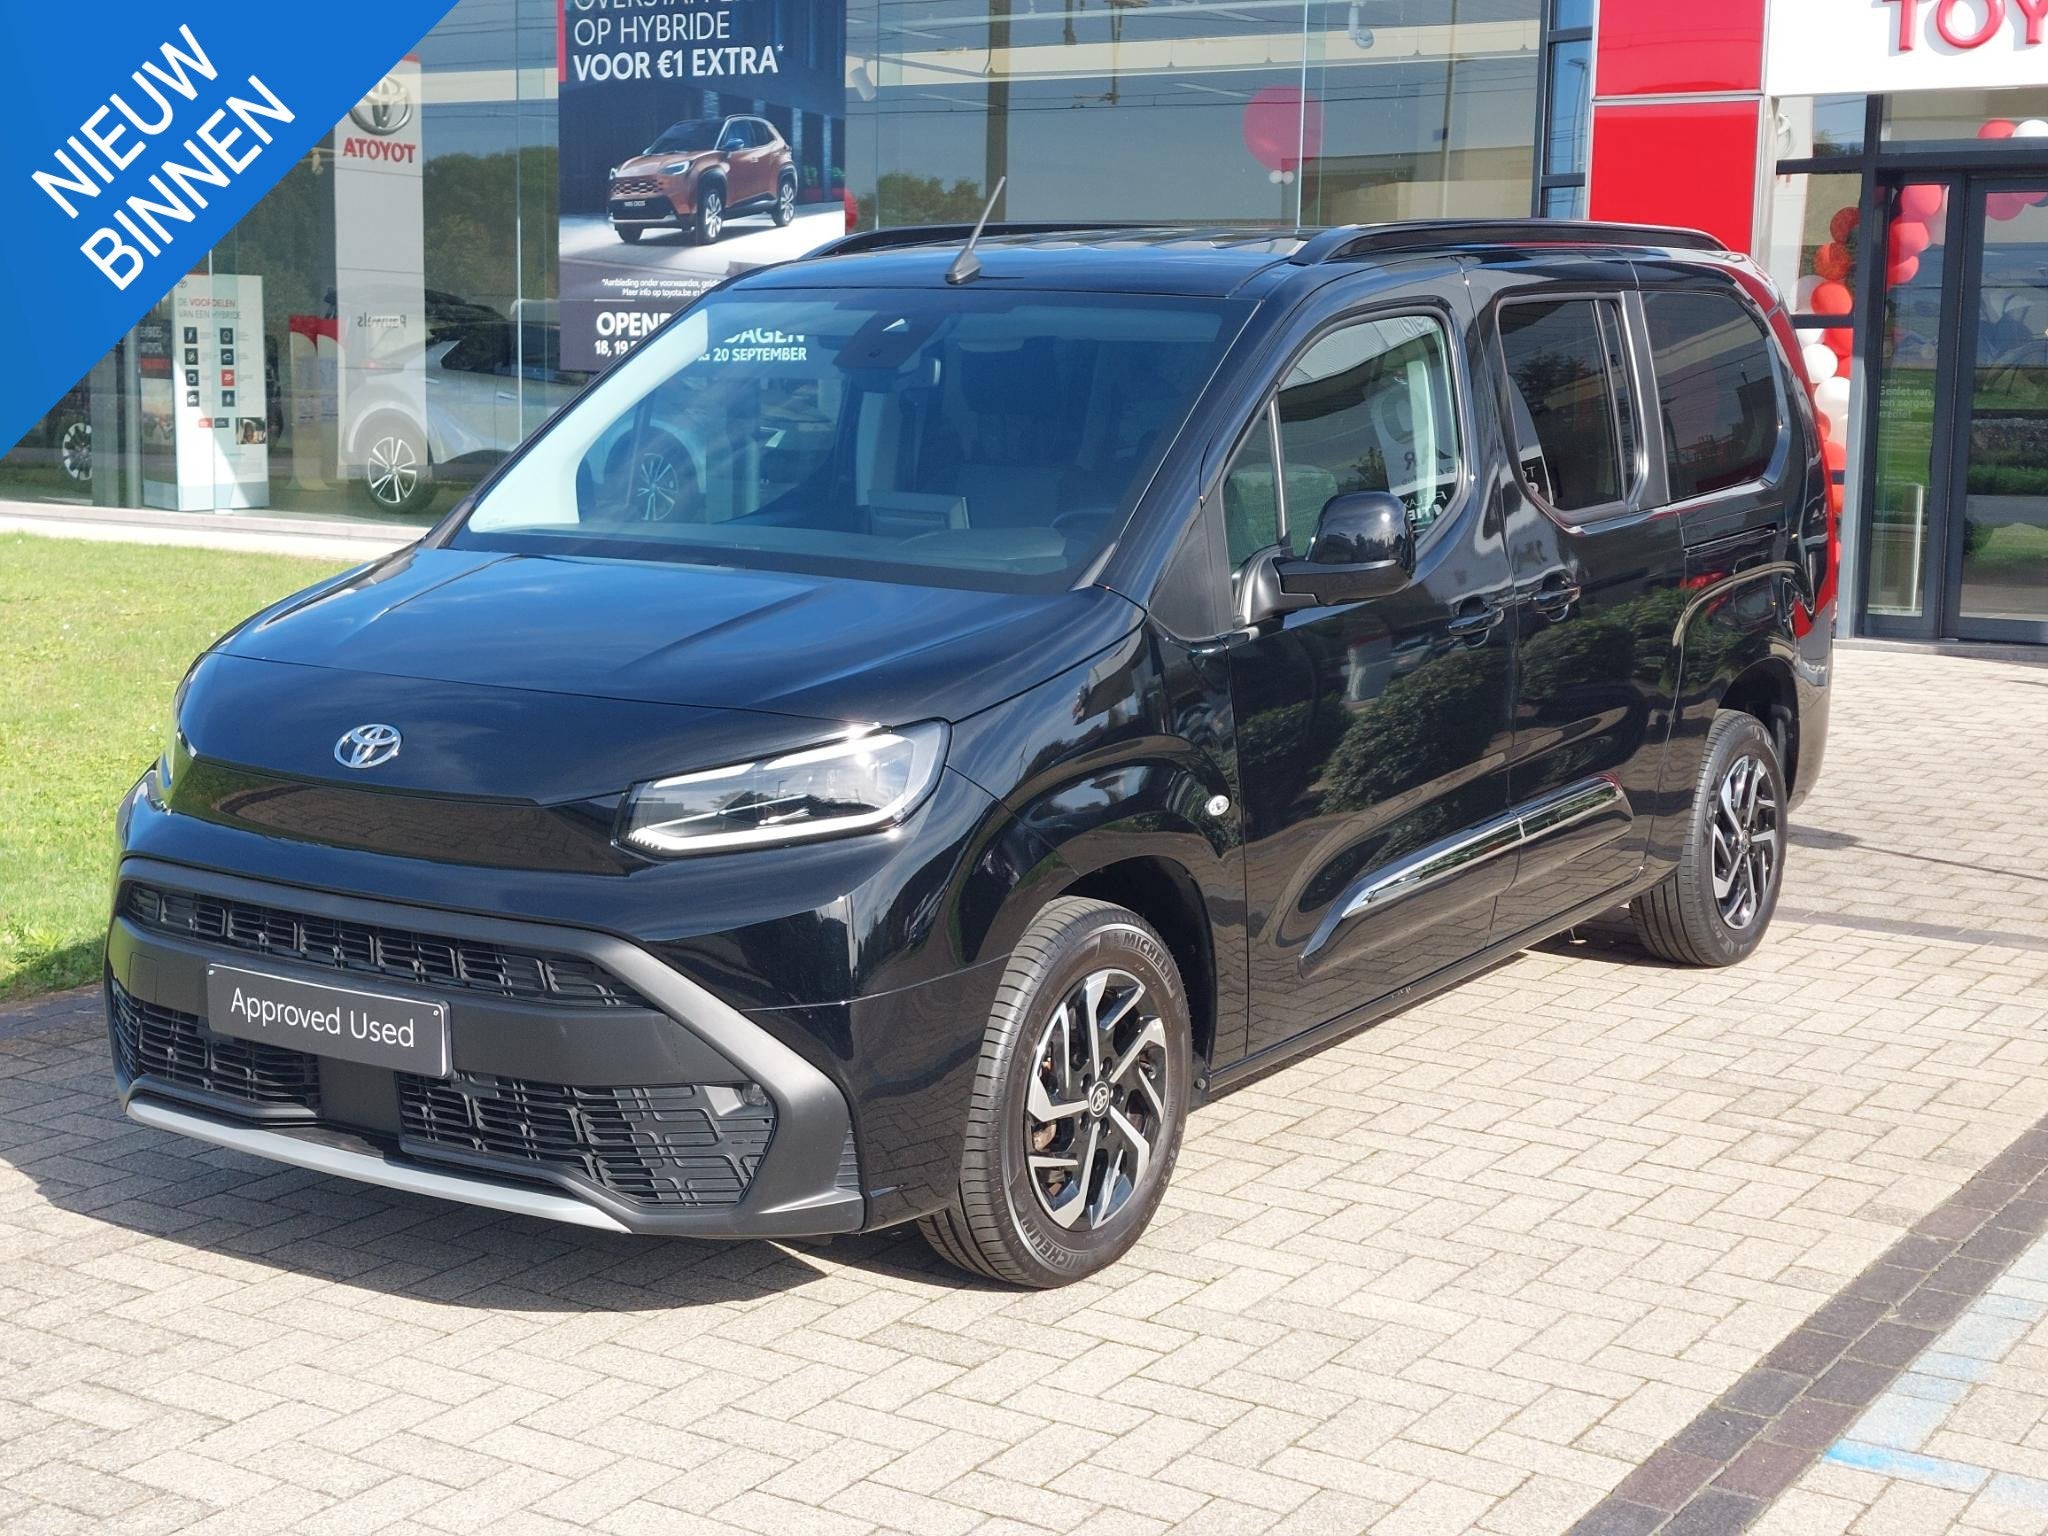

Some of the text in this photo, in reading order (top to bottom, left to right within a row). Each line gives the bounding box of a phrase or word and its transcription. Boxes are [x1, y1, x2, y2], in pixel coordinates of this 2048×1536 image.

[574, 11, 730, 46] OP HYBRIDE
[573, 50, 651, 81] VOOR
[657, 50, 683, 78] €1
[594, 339, 613, 357] 18,
[614, 340, 629, 355] 19
[713, 347, 729, 362] 20
[732, 346, 807, 362] SEPTEMBER
[230, 987, 415, 1048] Approved Used
